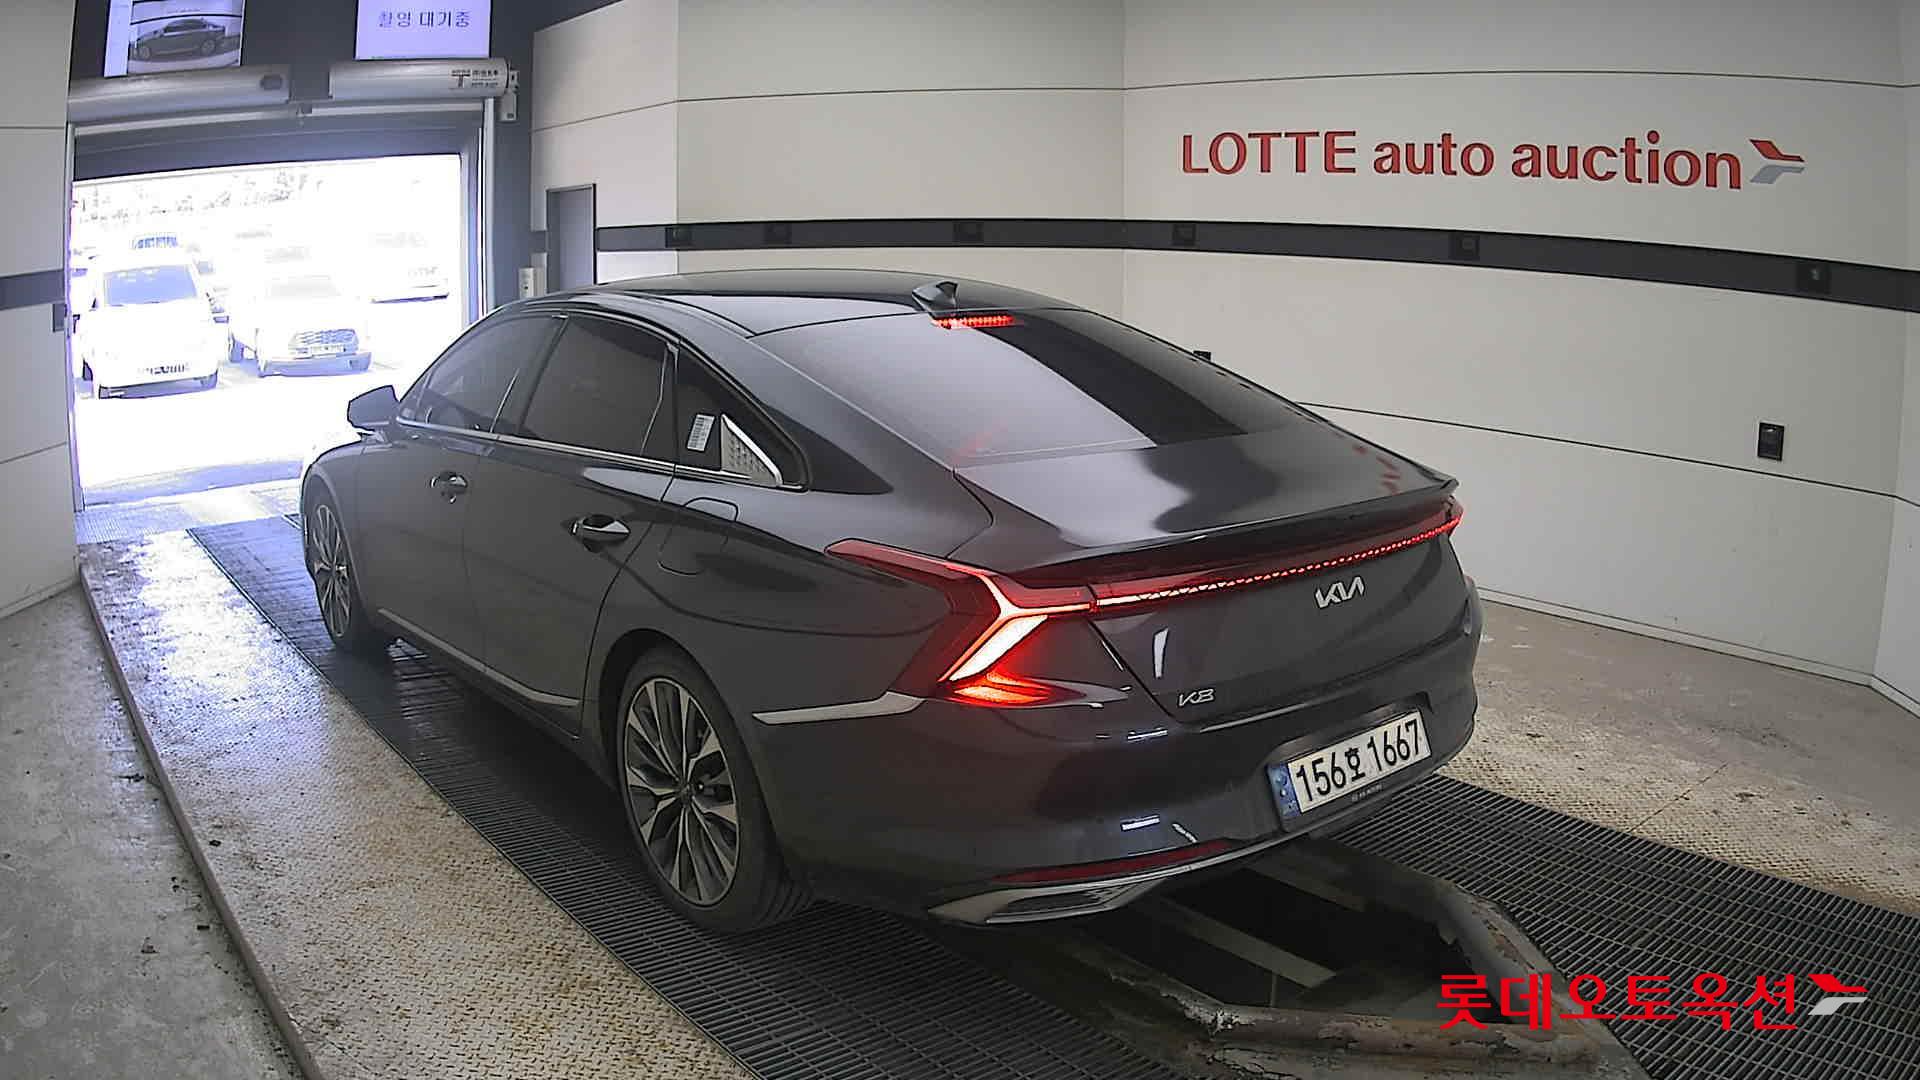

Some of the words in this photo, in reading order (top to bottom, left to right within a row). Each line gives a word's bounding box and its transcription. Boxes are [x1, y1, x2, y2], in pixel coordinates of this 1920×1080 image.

[419, 10, 470, 28] 대기중
[1182, 130, 1357, 175] LOTTE
[1373, 132, 1495, 178] auto
[1511, 130, 1742, 190] auction
[1178, 688, 1215, 707] K8
[1296, 747, 1366, 802] 156호
[1367, 718, 1419, 772] 1667
